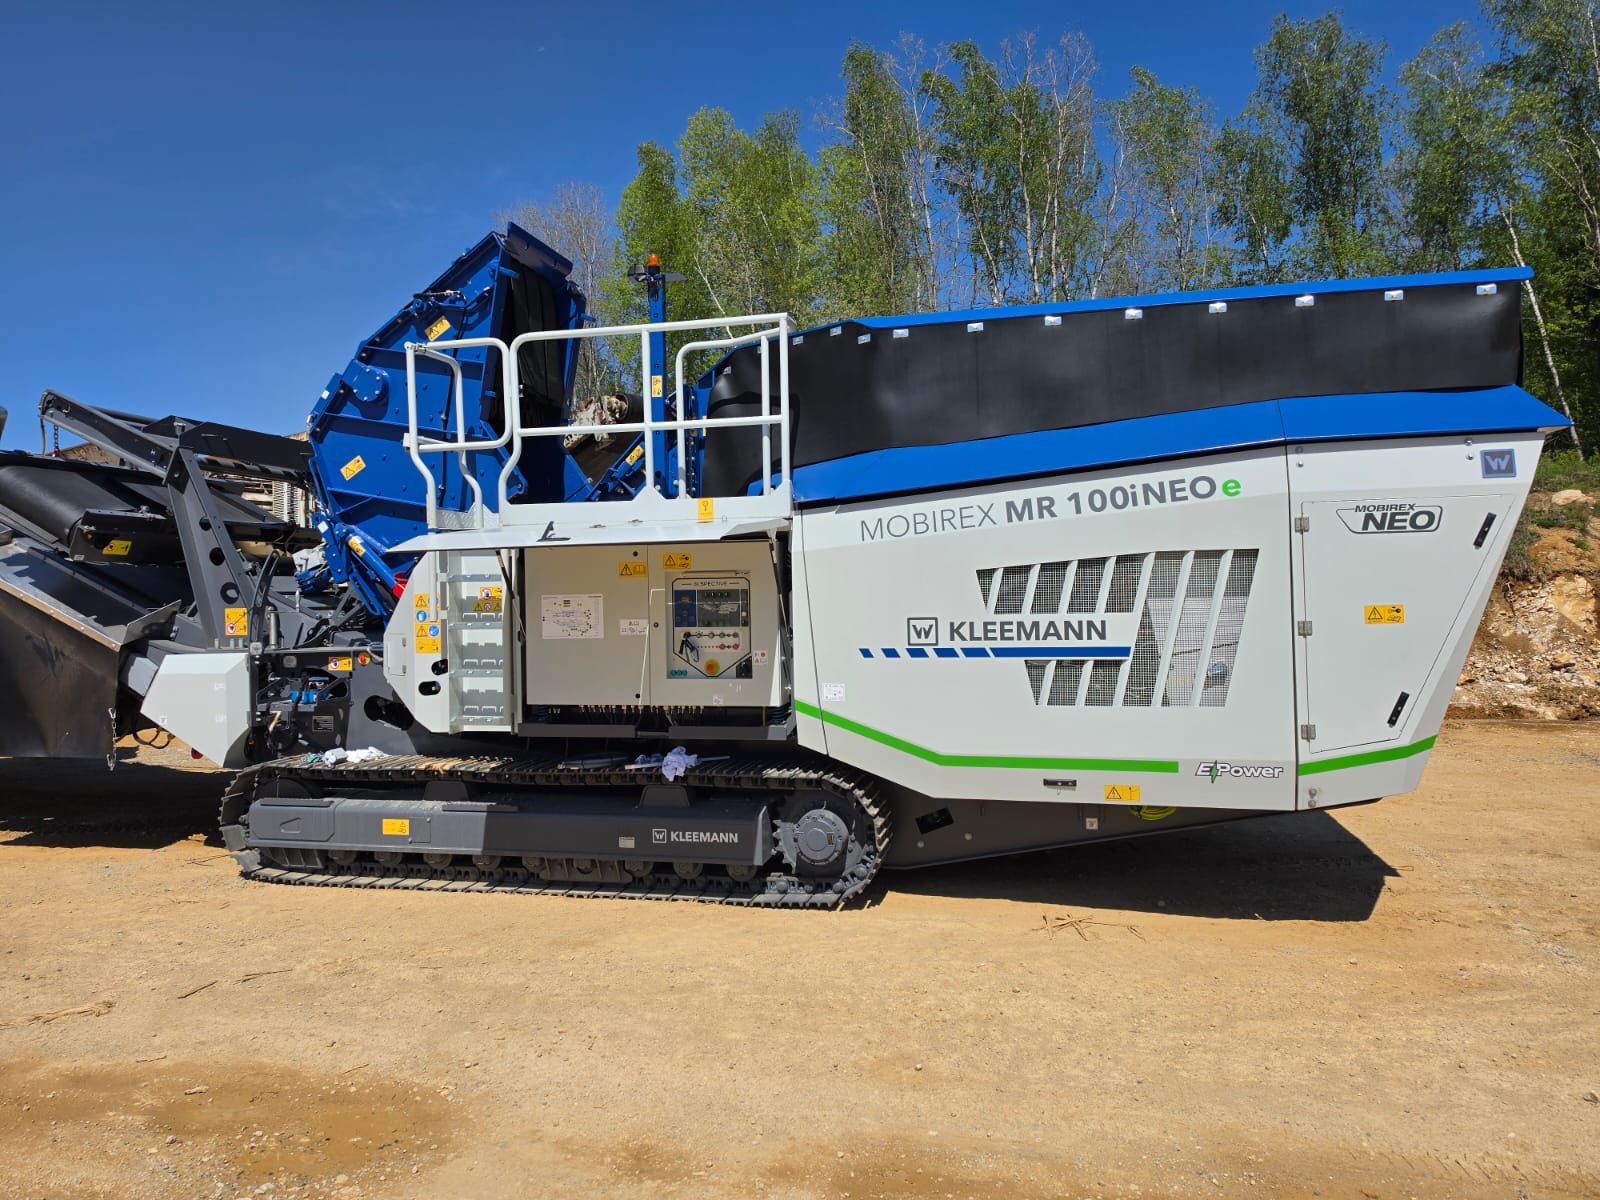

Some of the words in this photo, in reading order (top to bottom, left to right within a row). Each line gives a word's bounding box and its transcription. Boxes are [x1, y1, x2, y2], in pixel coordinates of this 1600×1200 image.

[860, 502, 998, 542] MOBIREX
[1005, 495, 1059, 524] MR
[1354, 503, 1417, 513] MOBIREX
[1361, 510, 1436, 532] NEO
[949, 619, 1108, 643] KLEEMANN
[670, 831, 739, 843] KLEEMANN
